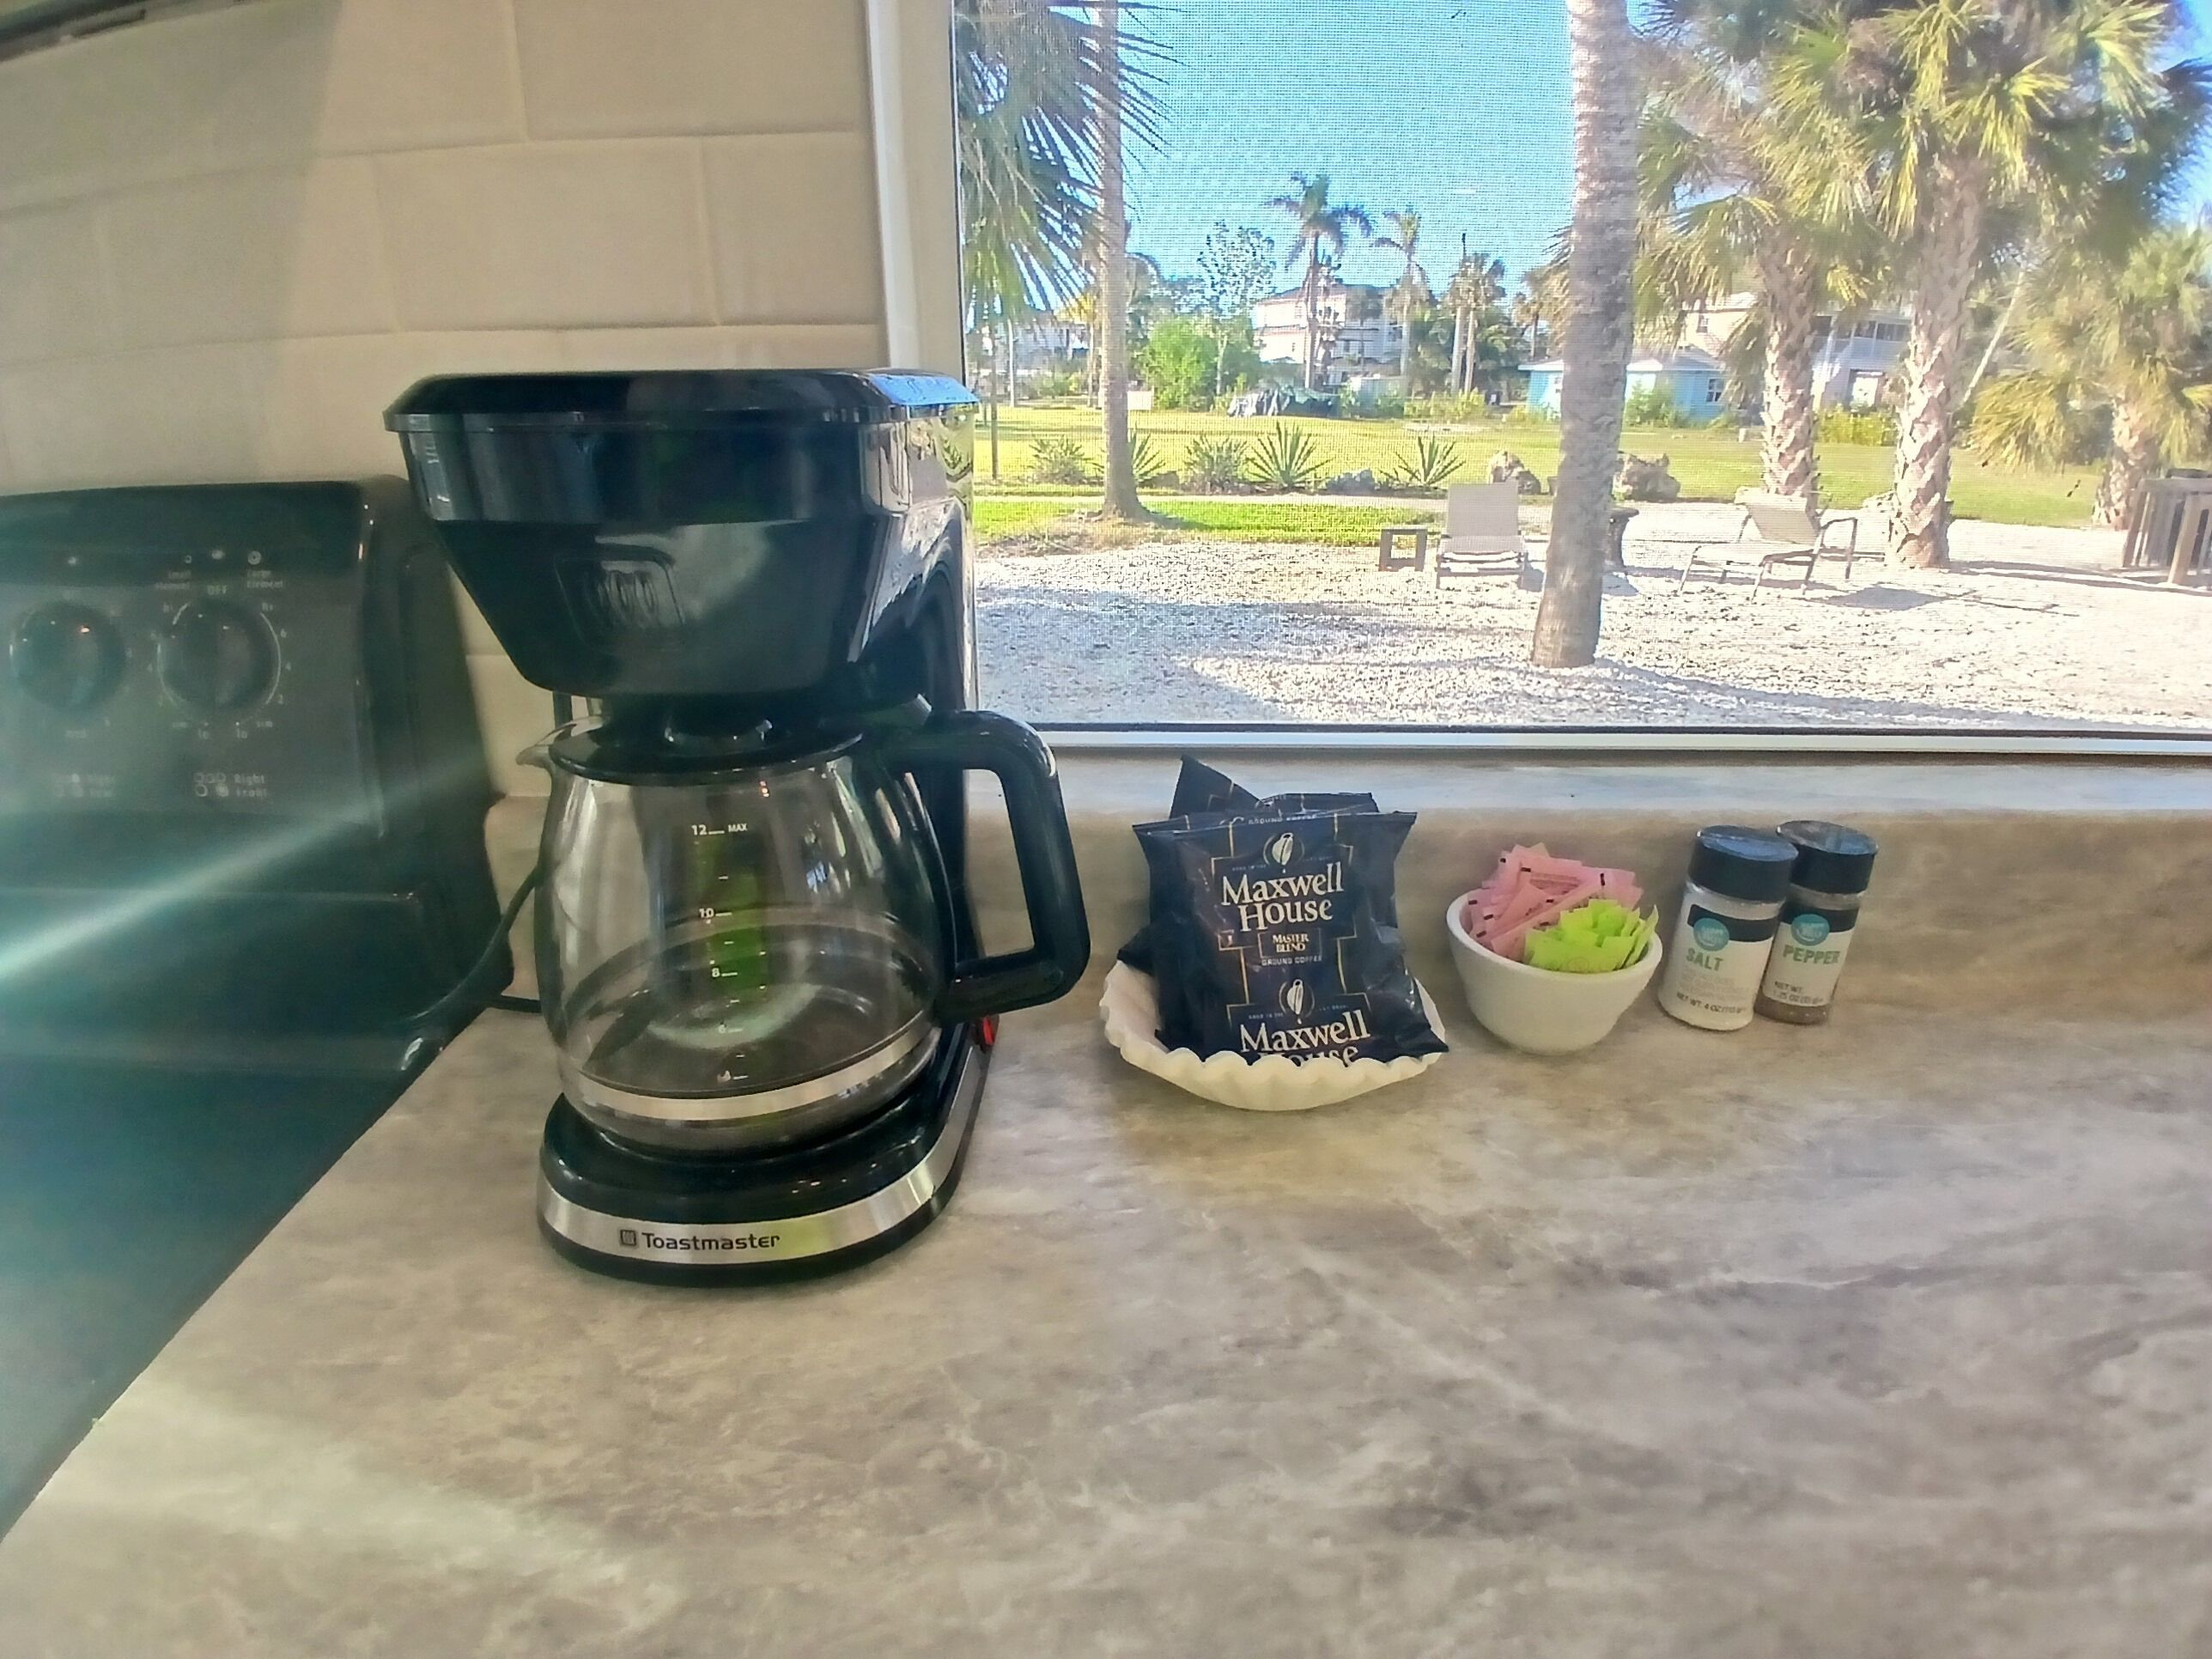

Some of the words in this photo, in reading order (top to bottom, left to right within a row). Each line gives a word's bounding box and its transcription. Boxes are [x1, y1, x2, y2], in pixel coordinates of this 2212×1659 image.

[691, 824, 708, 836] 12
[727, 823, 748, 833] MAX
[1220, 861, 1345, 906] Maxwell
[1238, 899, 1334, 933] House
[1261, 957, 1292, 966] GROUND
[1685, 947, 1723, 971] SALT
[1782, 944, 1841, 964] PEPPER
[712, 968, 720, 978] 8
[1239, 1009, 1371, 1053] Maxwell
[641, 1231, 781, 1251] Toastmaster
